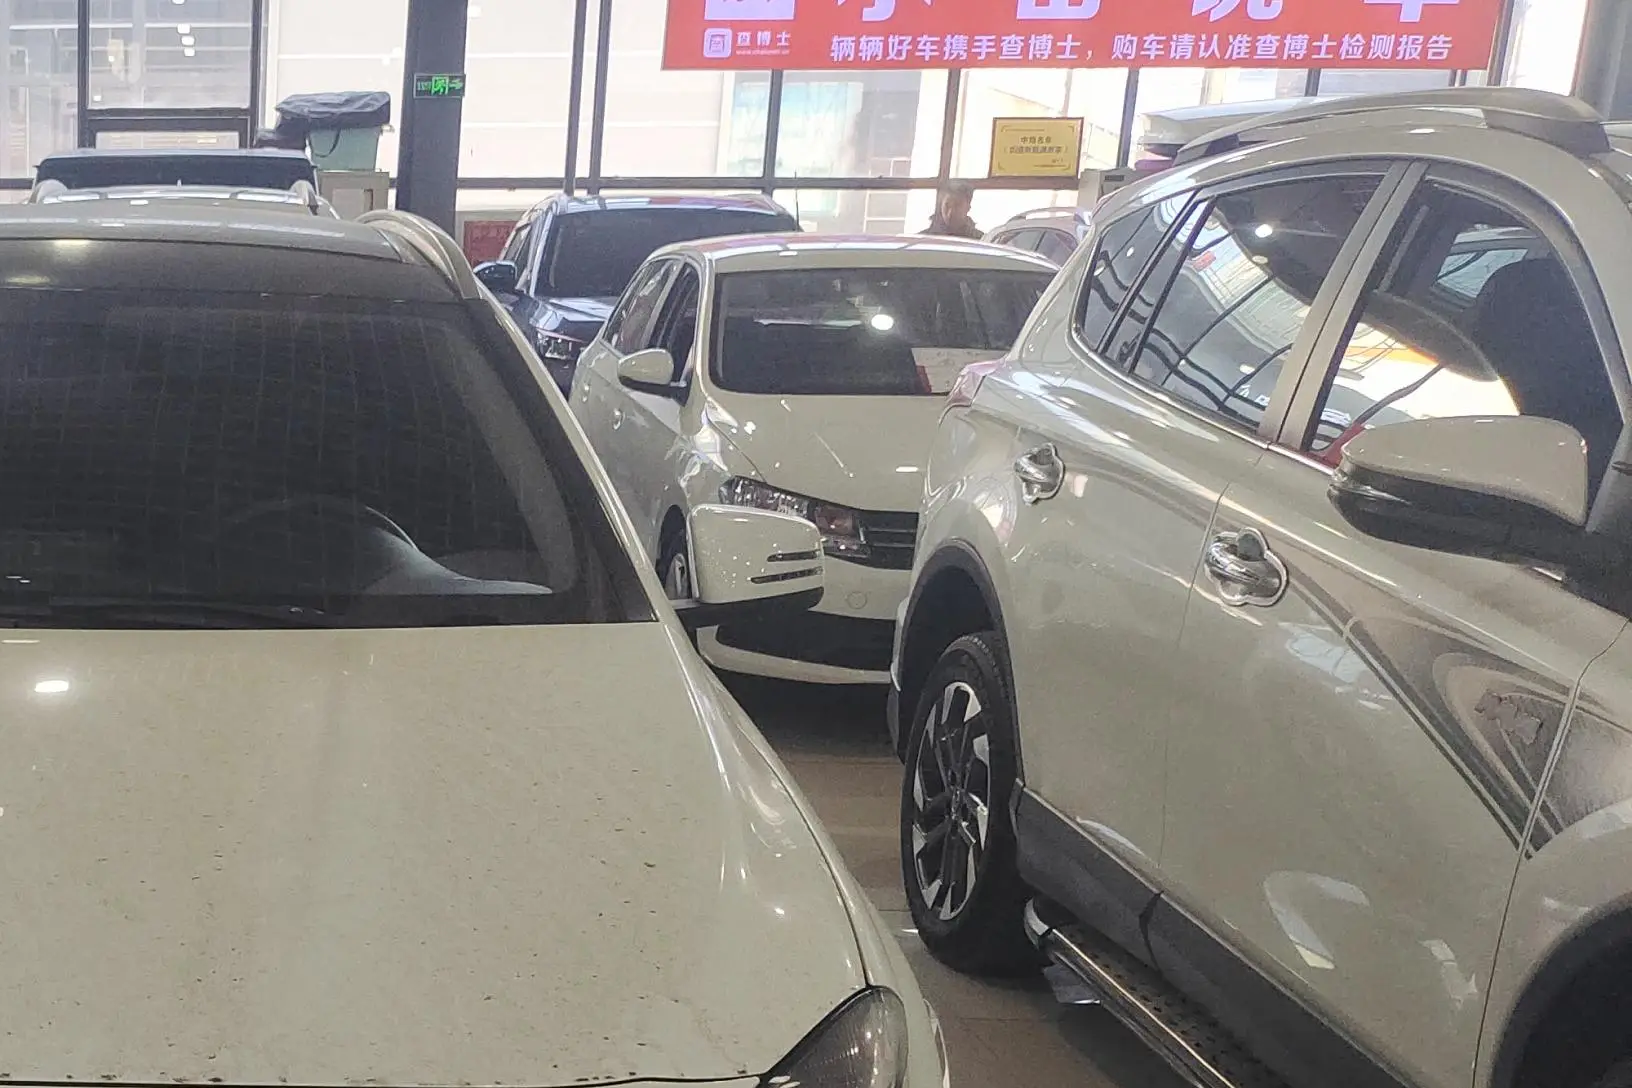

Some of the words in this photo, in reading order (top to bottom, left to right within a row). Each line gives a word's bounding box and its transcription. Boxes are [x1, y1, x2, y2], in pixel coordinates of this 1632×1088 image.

[736, 30, 791, 47] 查博士
[830, 33, 1453, 63] 辆辆好车携手查博士，购车请认准查博士检测报告
